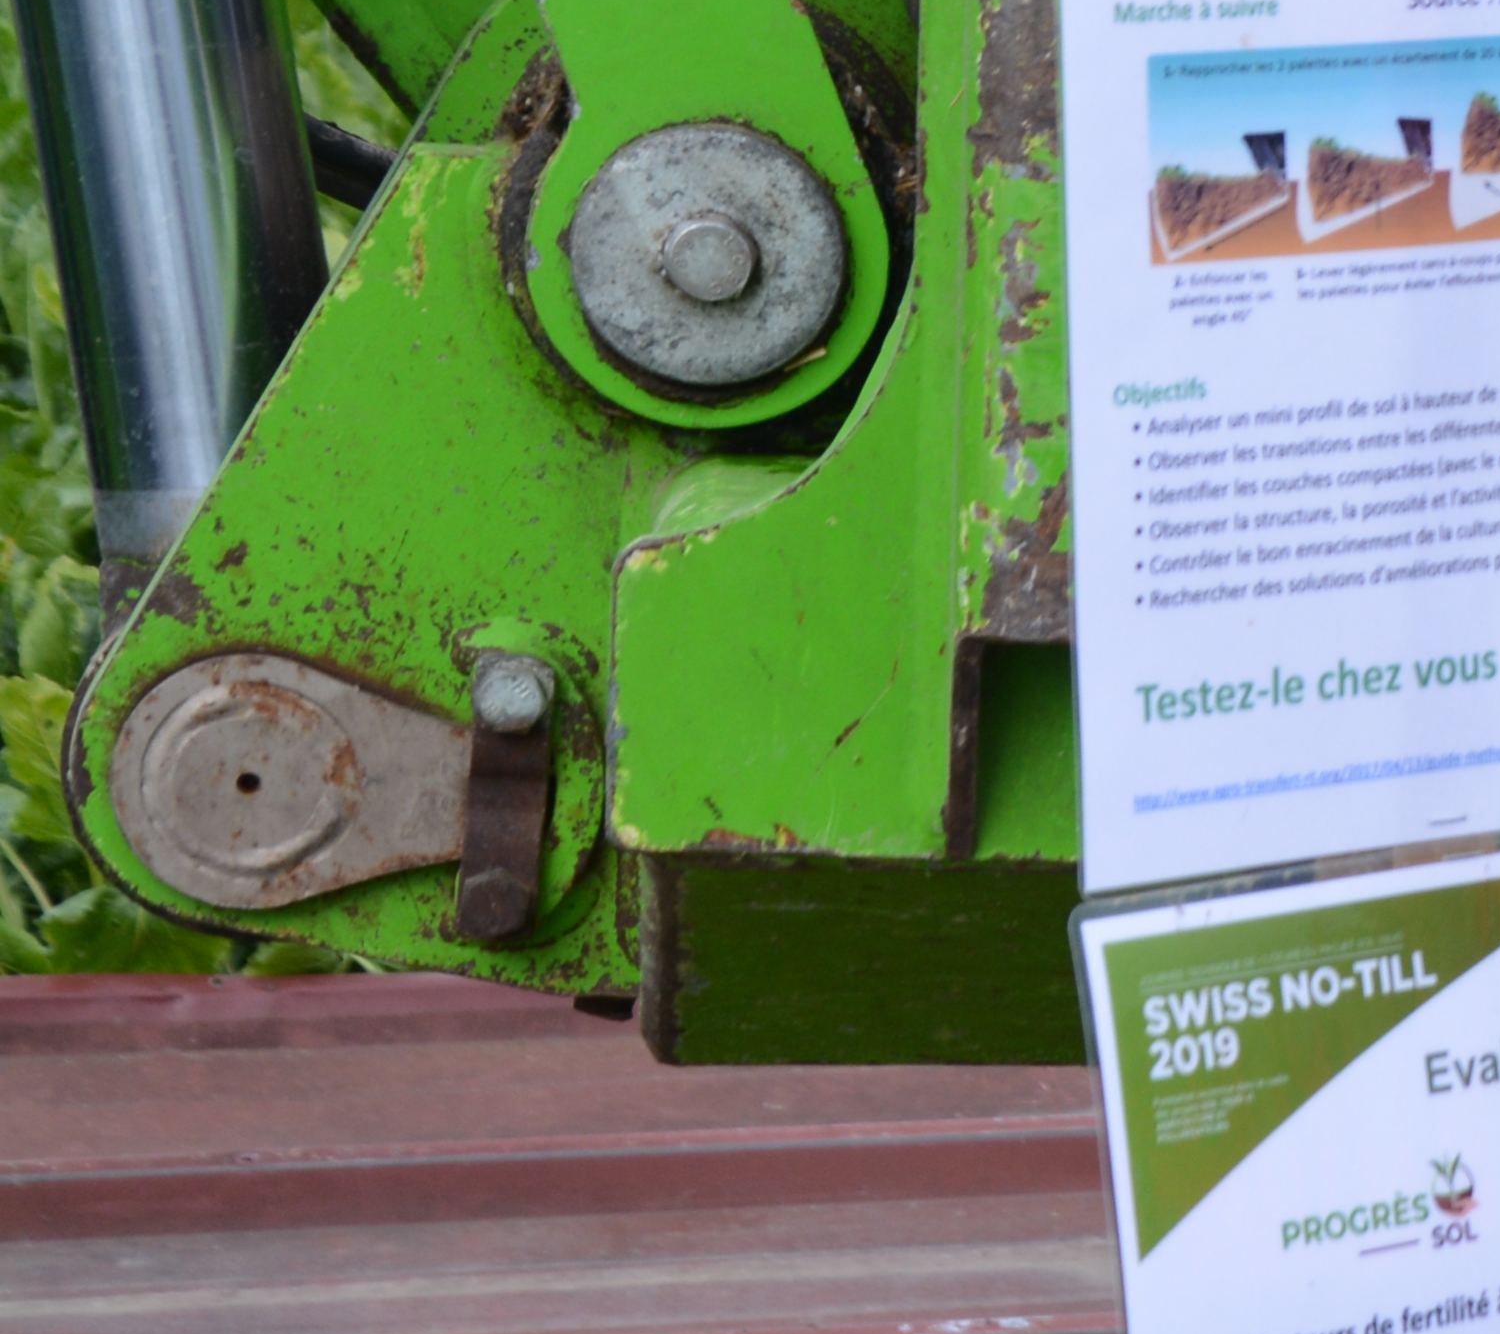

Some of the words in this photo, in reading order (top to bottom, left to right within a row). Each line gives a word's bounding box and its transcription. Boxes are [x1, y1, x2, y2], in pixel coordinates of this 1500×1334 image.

[1114, 0, 1193, 23] Marche
[1113, 378, 1206, 407] Objectifs
[1148, 415, 1222, 435] Analyser
[1228, 413, 1249, 429] un
[1255, 407, 1292, 426] mini
[1298, 400, 1342, 425] profil
[1348, 400, 1367, 418] de
[1373, 396, 1395, 416] sol
[1401, 395, 1409, 412] à
[1414, 390, 1472, 410] hauteur
[1478, 387, 1496, 403] de
[1150, 481, 1228, 506] Identifier
[1234, 479, 1257, 497] les
[1263, 472, 1332, 494] couches
[1338, 461, 1432, 487] compactées
[1438, 457, 1475, 477] (avec
[1481, 453, 1493, 470] le
[1150, 518, 1228, 540] Observer
[1234, 513, 1248, 531] la
[1254, 507, 1336, 530] structure,
[1342, 502, 1356, 520] la
[1362, 493, 1426, 518] porosité
[1432, 493, 1445, 509] et
[1151, 583, 1247, 608] Rechercher
[1253, 579, 1282, 598] des
[1288, 571, 1364, 594] solutions
[1370, 556, 1489, 585] d'améliorations
[1137, 666, 1305, 723] Testez-le
[1317, 659, 1402, 701] chez
[1414, 650, 1497, 688] vous
[1143, 976, 1273, 1037] SWISS
[1279, 950, 1438, 1013] NO-TILL
[1148, 1026, 1240, 1081] 2019
[1281, 1192, 1429, 1250] PROGRÈS
[1432, 1221, 1478, 1249] SOL
[1401, 1294, 1489, 1334] fertilité
